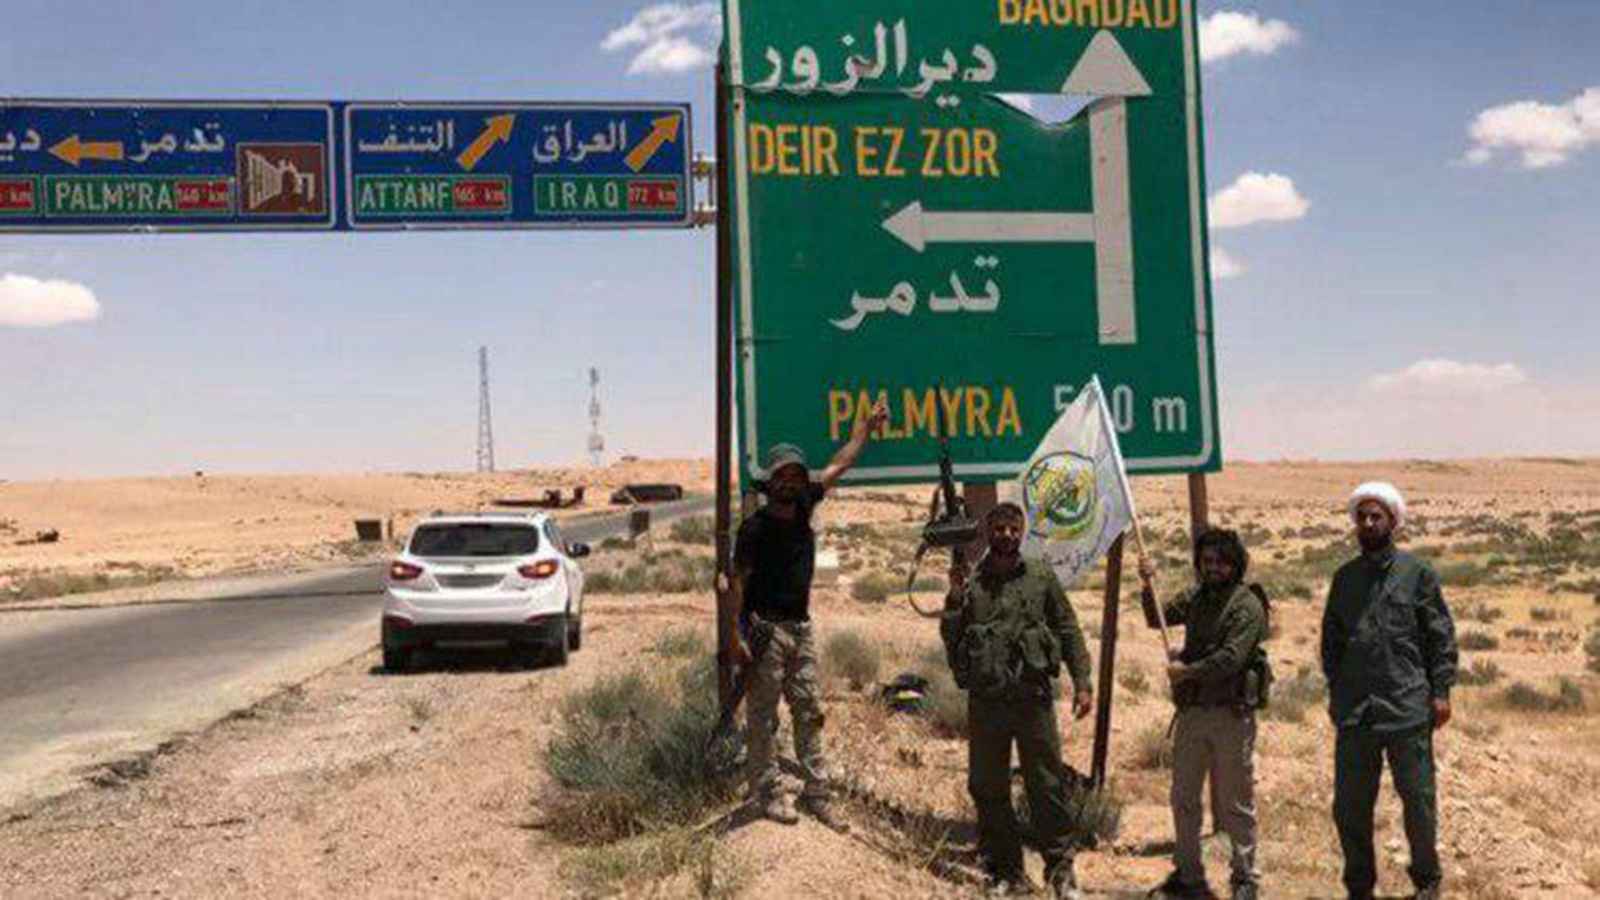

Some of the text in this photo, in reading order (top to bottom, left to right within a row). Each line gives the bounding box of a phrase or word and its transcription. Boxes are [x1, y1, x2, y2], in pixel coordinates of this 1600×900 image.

[998, 0, 1178, 29] BAGHDAD
[128, 121, 226, 164] تدمر
[358, 118, 455, 152] التنف
[532, 118, 627, 163] العراق
[750, 124, 1000, 178] DEIR EZ ZOR
[360, 182, 451, 209] ATTANF
[548, 182, 620, 210] IRAQ
[828, 255, 1001, 331] تدمر
[1054, 384, 1134, 433] 50
[1152, 395, 1188, 433] m
